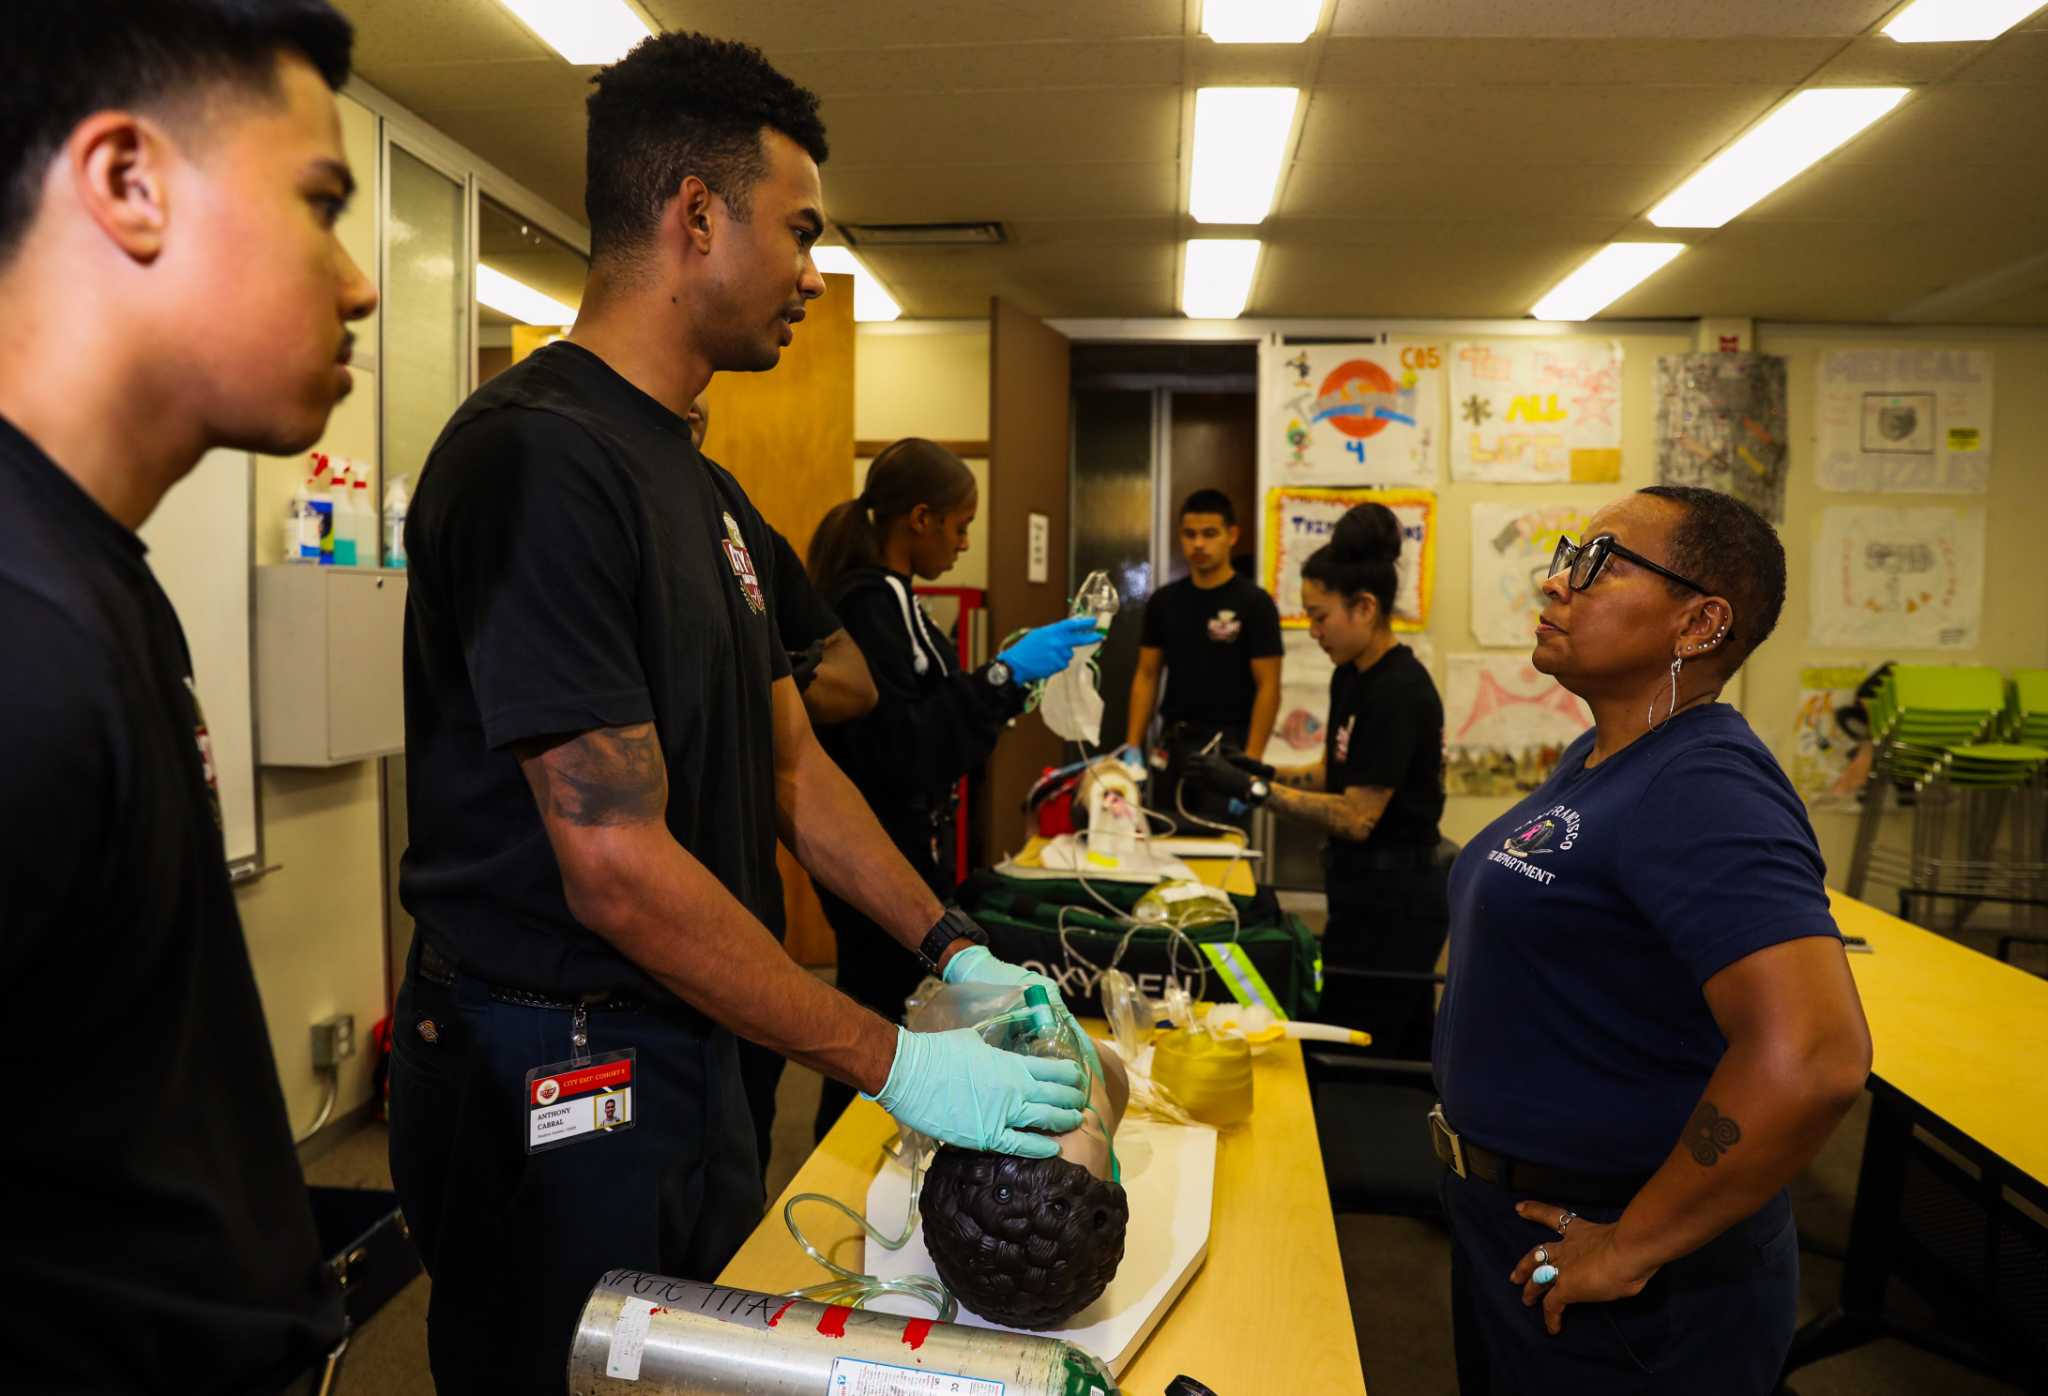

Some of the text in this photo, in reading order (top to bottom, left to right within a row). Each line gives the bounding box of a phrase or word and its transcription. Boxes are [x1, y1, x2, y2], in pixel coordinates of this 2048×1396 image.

[1505, 393, 1568, 424] ALL
[1346, 440, 1365, 464] 4
[538, 1107, 571, 1120] ANTHONY
[537, 1118, 564, 1130] CABRAL
